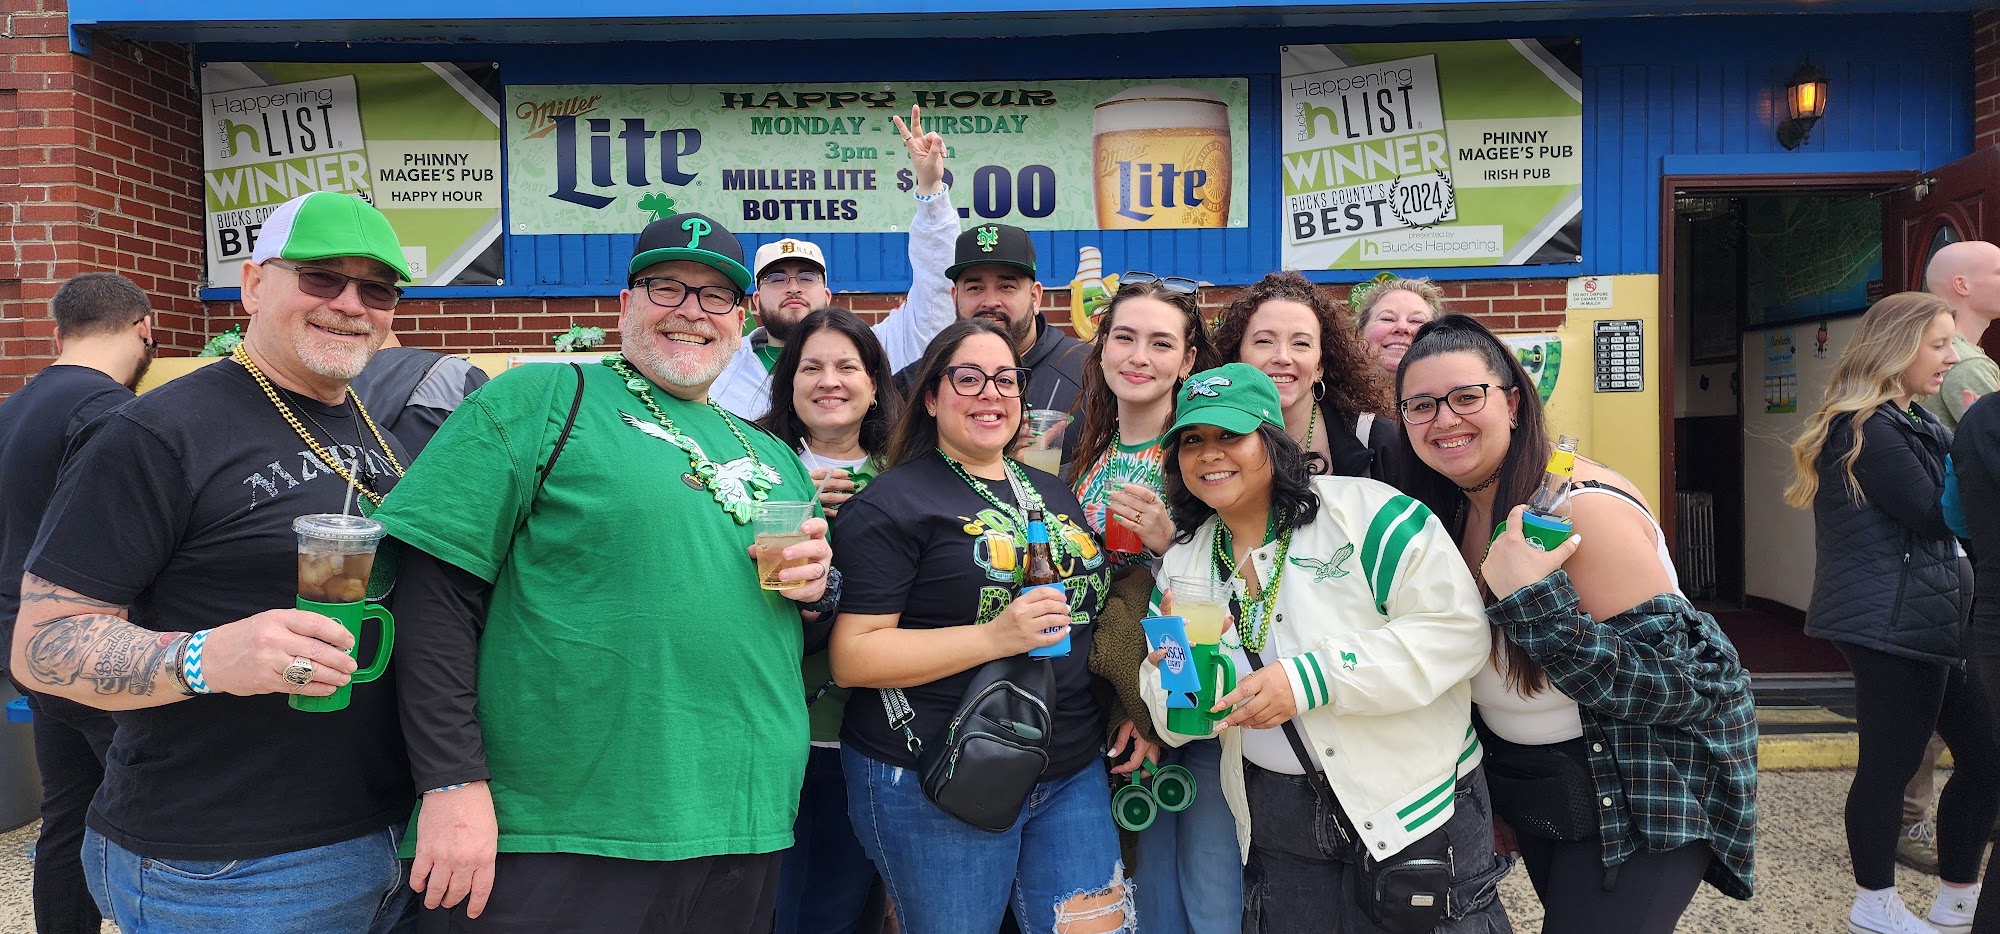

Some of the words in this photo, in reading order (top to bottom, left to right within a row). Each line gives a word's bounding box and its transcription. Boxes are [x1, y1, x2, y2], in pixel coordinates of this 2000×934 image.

[1290, 68, 1412, 98] Happening
[211, 88, 333, 115] Happening
[719, 90, 896, 110] HAPPY
[911, 88, 1057, 109] HOUR
[1342, 85, 1413, 138] LIST
[262, 104, 333, 156] LIST
[515, 94, 602, 140] Miller
[750, 116, 866, 136] MONDAY
[1295, 101, 1308, 141] Bucks
[218, 119, 231, 158] Bucks
[824, 141, 878, 163] 3pm
[1483, 131, 1548, 145] PHINNY
[403, 153, 469, 166] PHINNY
[548, 115, 702, 210] Lite
[1282, 133, 1448, 190] WINNER
[1459, 146, 1534, 161] MAGEE'S
[1540, 145, 1573, 158] PUB
[205, 153, 371, 208] WINNER
[380, 168, 455, 182] MAGEE'S
[461, 168, 494, 182] PUB
[722, 169, 816, 191] MILLER
[823, 169, 877, 191] LITE
[1484, 169, 1518, 180] IRISH
[1523, 168, 1551, 179] PUB
[391, 191, 438, 202] HAPPY
[442, 190, 483, 202] HOUR
[896, 165, 1056, 219] $.00
[1115, 161, 1206, 222] Lite
[1291, 192, 1327, 212] BUCKS
[1332, 183, 1386, 206] COUNTY'S
[1400, 181, 1443, 215] 2024
[217, 209, 252, 229] BUCKS
[742, 199, 858, 221] BOTTLES
[1293, 199, 1387, 240] BEST
[681, 218, 712, 249] P
[1382, 241, 1422, 253] Bucks
